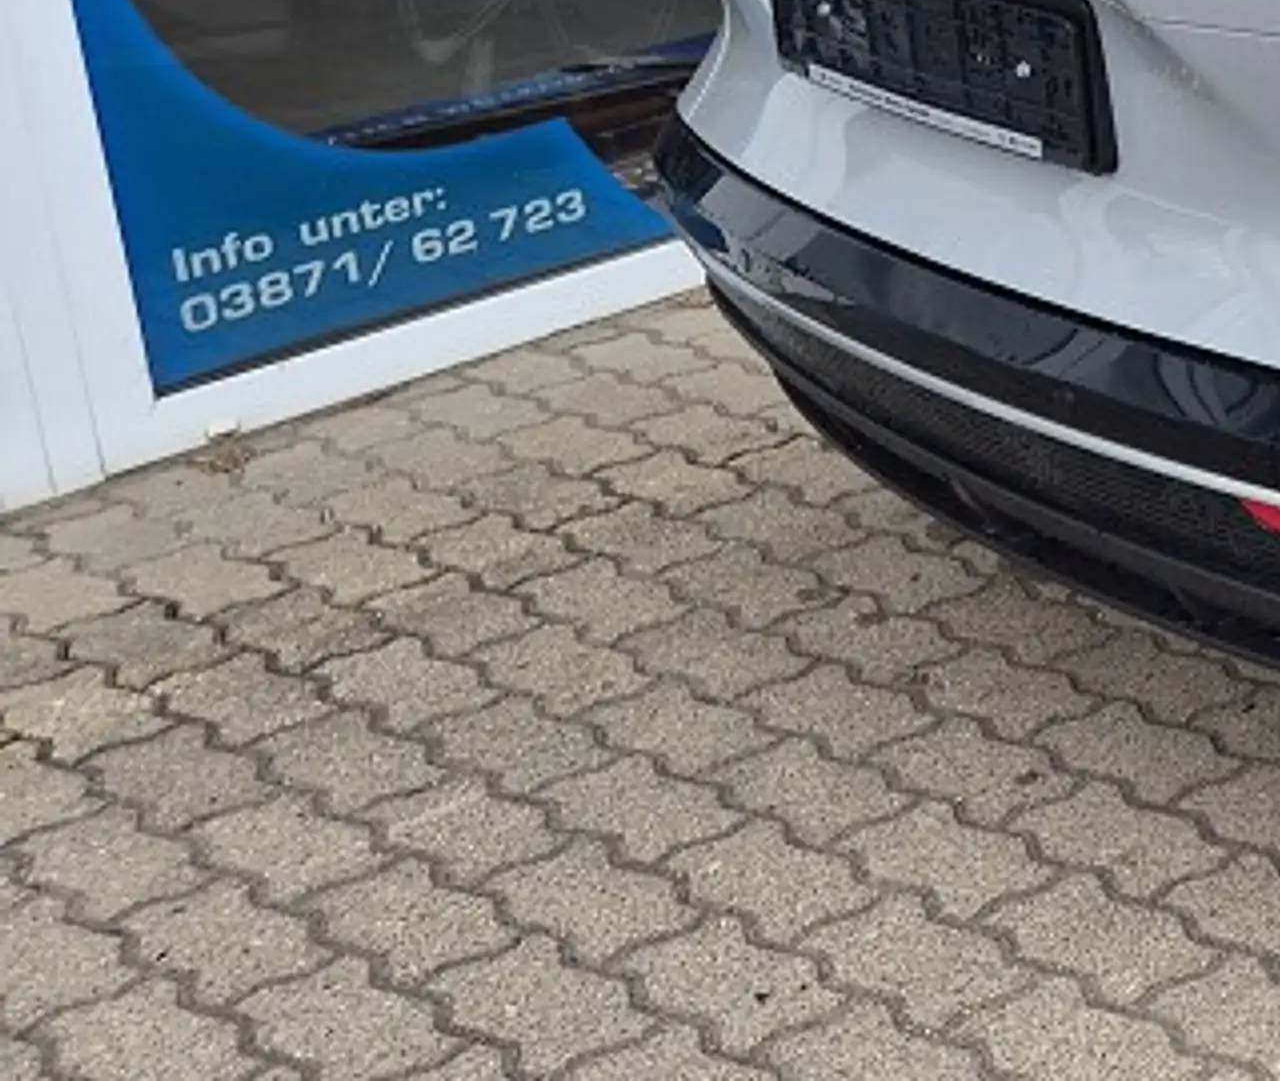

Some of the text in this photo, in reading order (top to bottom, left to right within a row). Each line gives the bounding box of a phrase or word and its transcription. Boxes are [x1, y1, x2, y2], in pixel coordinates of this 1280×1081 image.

[172, 182, 449, 283] Info unter:
[179, 188, 588, 334] 03871/ 62 723
